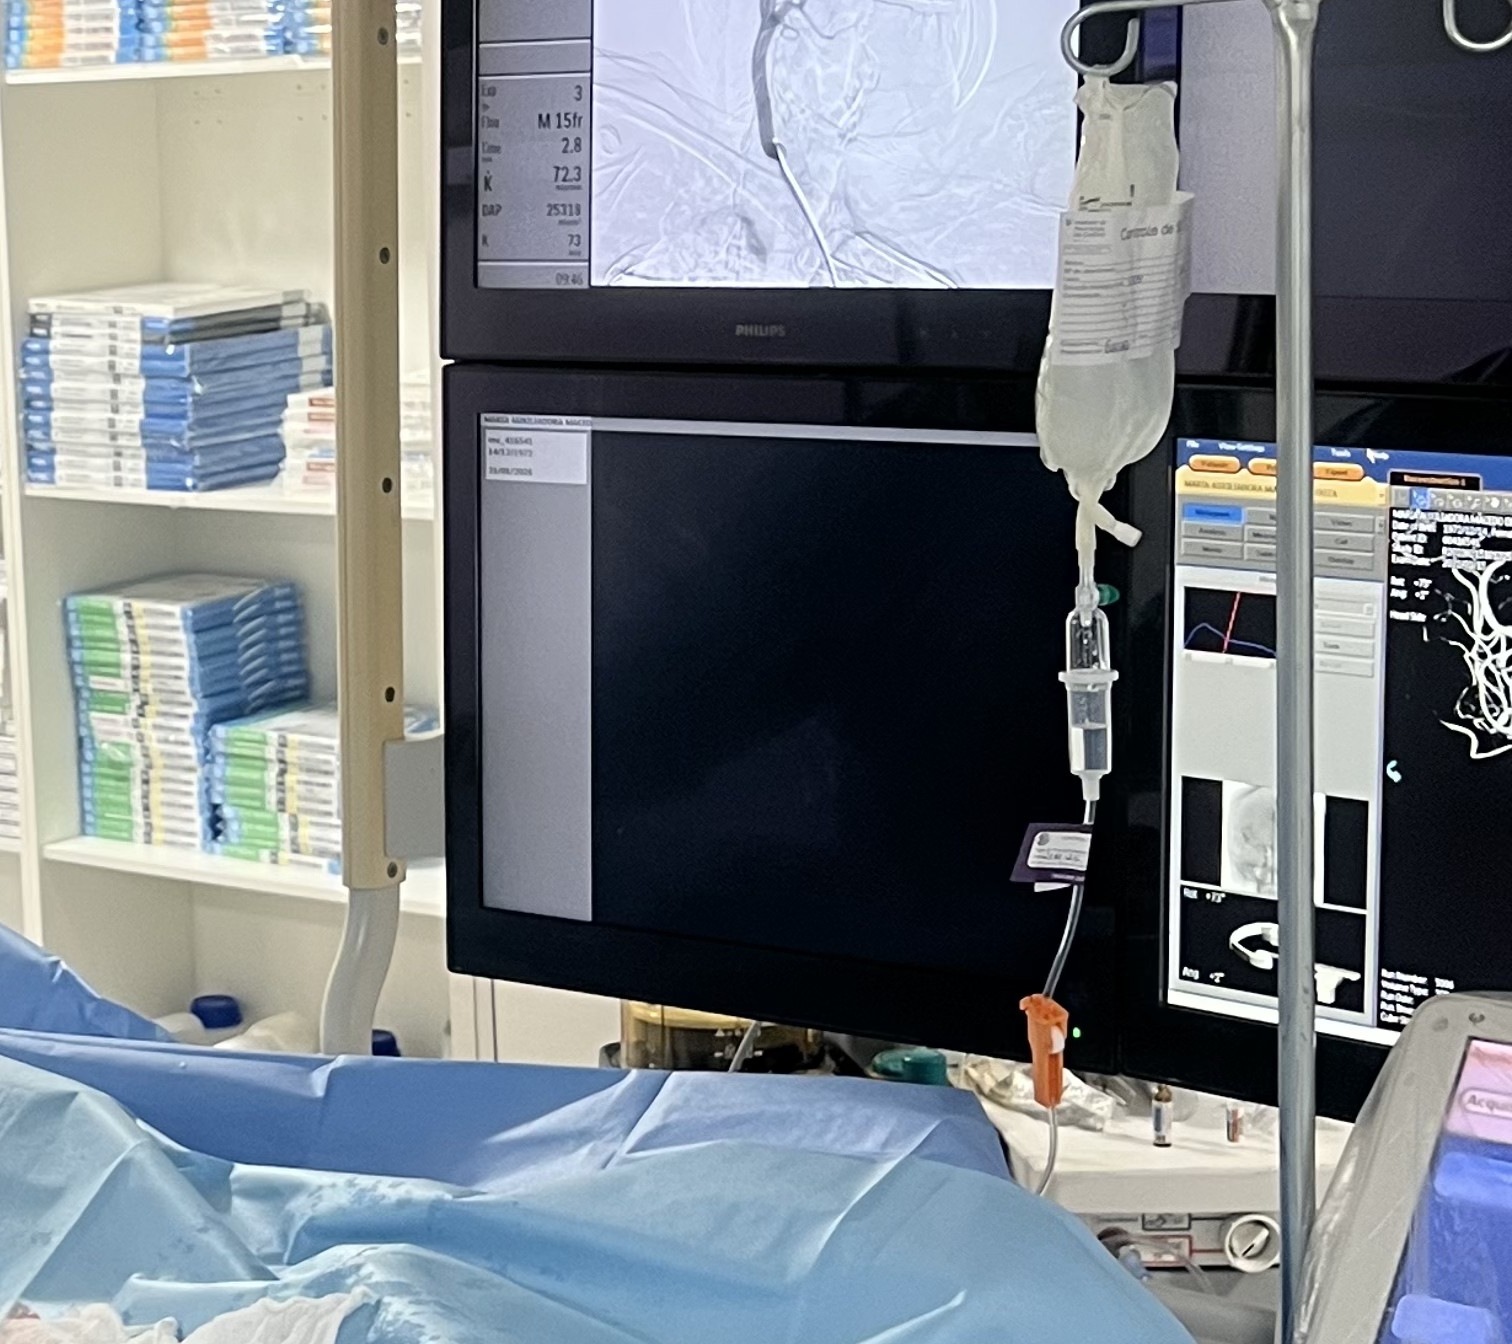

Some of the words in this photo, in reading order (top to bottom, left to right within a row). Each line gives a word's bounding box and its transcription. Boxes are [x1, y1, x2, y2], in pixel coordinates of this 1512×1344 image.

[574, 84, 583, 102] 3
[538, 113, 551, 129] M
[556, 111, 584, 129] 15fr
[561, 137, 583, 154] 2.8
[553, 165, 582, 183] 72.3
[735, 323, 786, 337] PHILIPS
